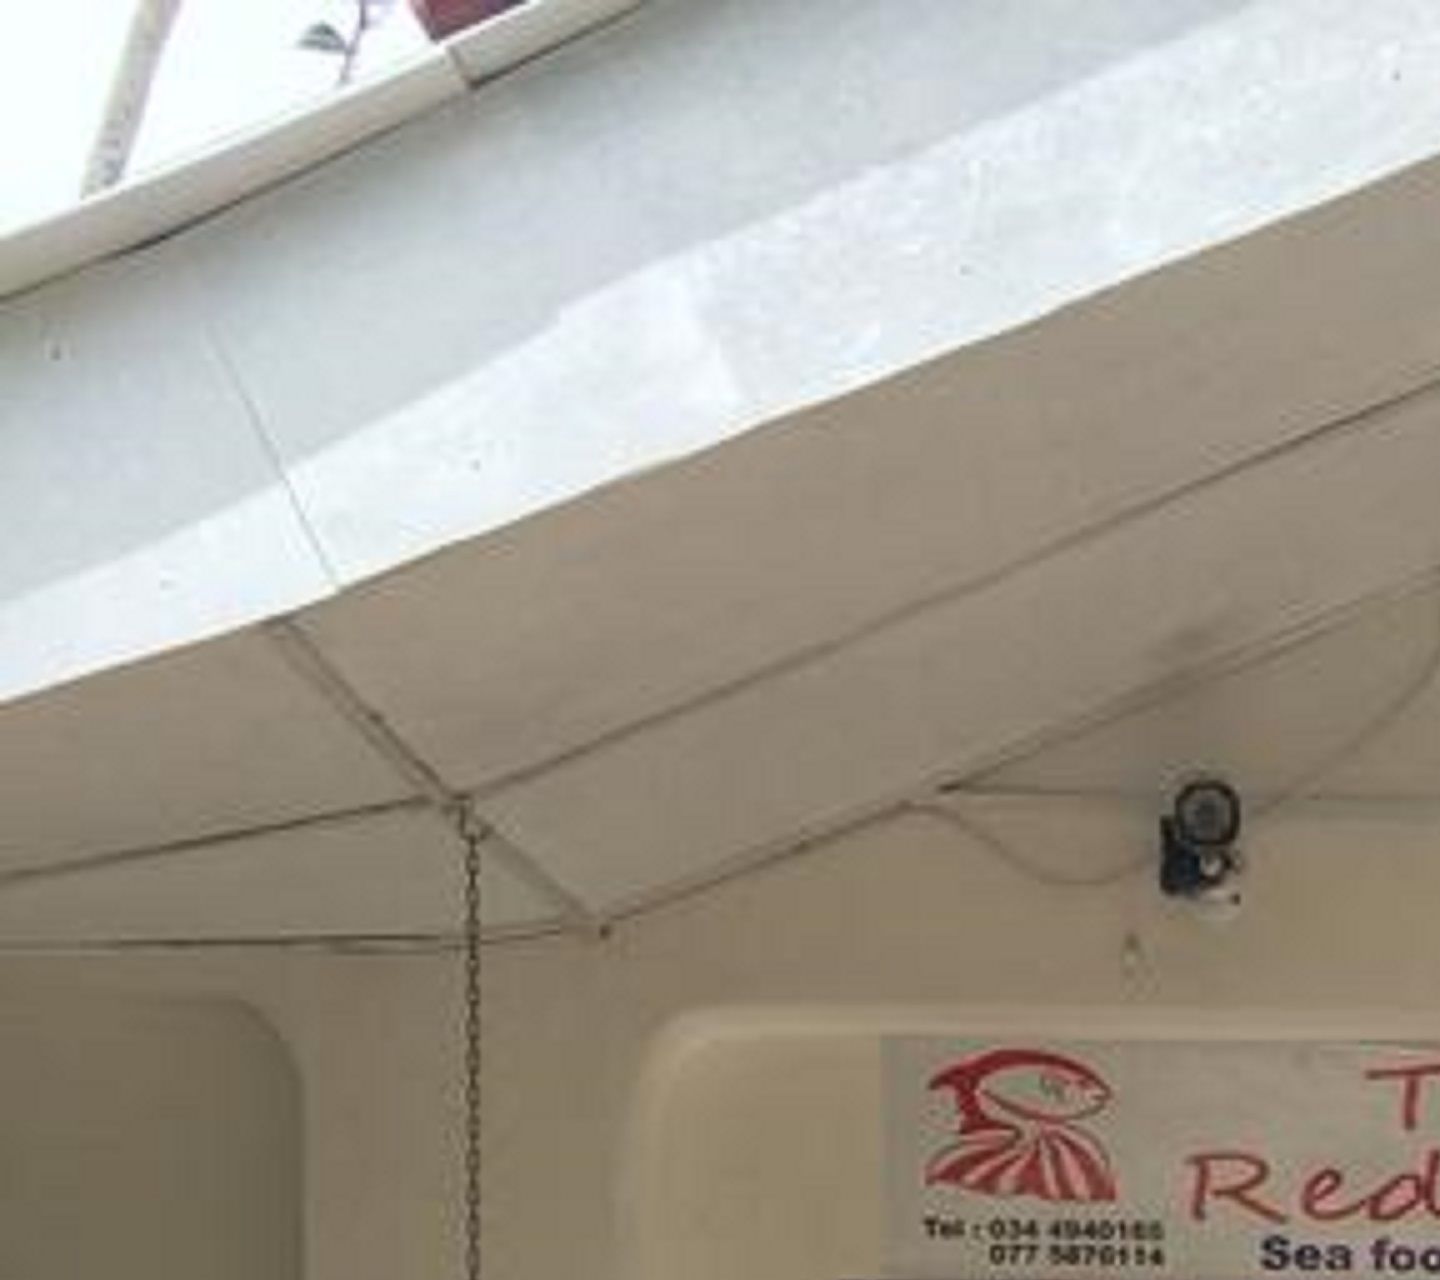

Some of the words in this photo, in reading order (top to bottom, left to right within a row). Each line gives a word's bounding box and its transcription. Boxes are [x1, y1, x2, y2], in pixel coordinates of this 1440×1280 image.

[988, 1217, 1040, 1241] 034
[988, 1244, 1040, 1266] 077
[1260, 1236, 1353, 1272] Sea
